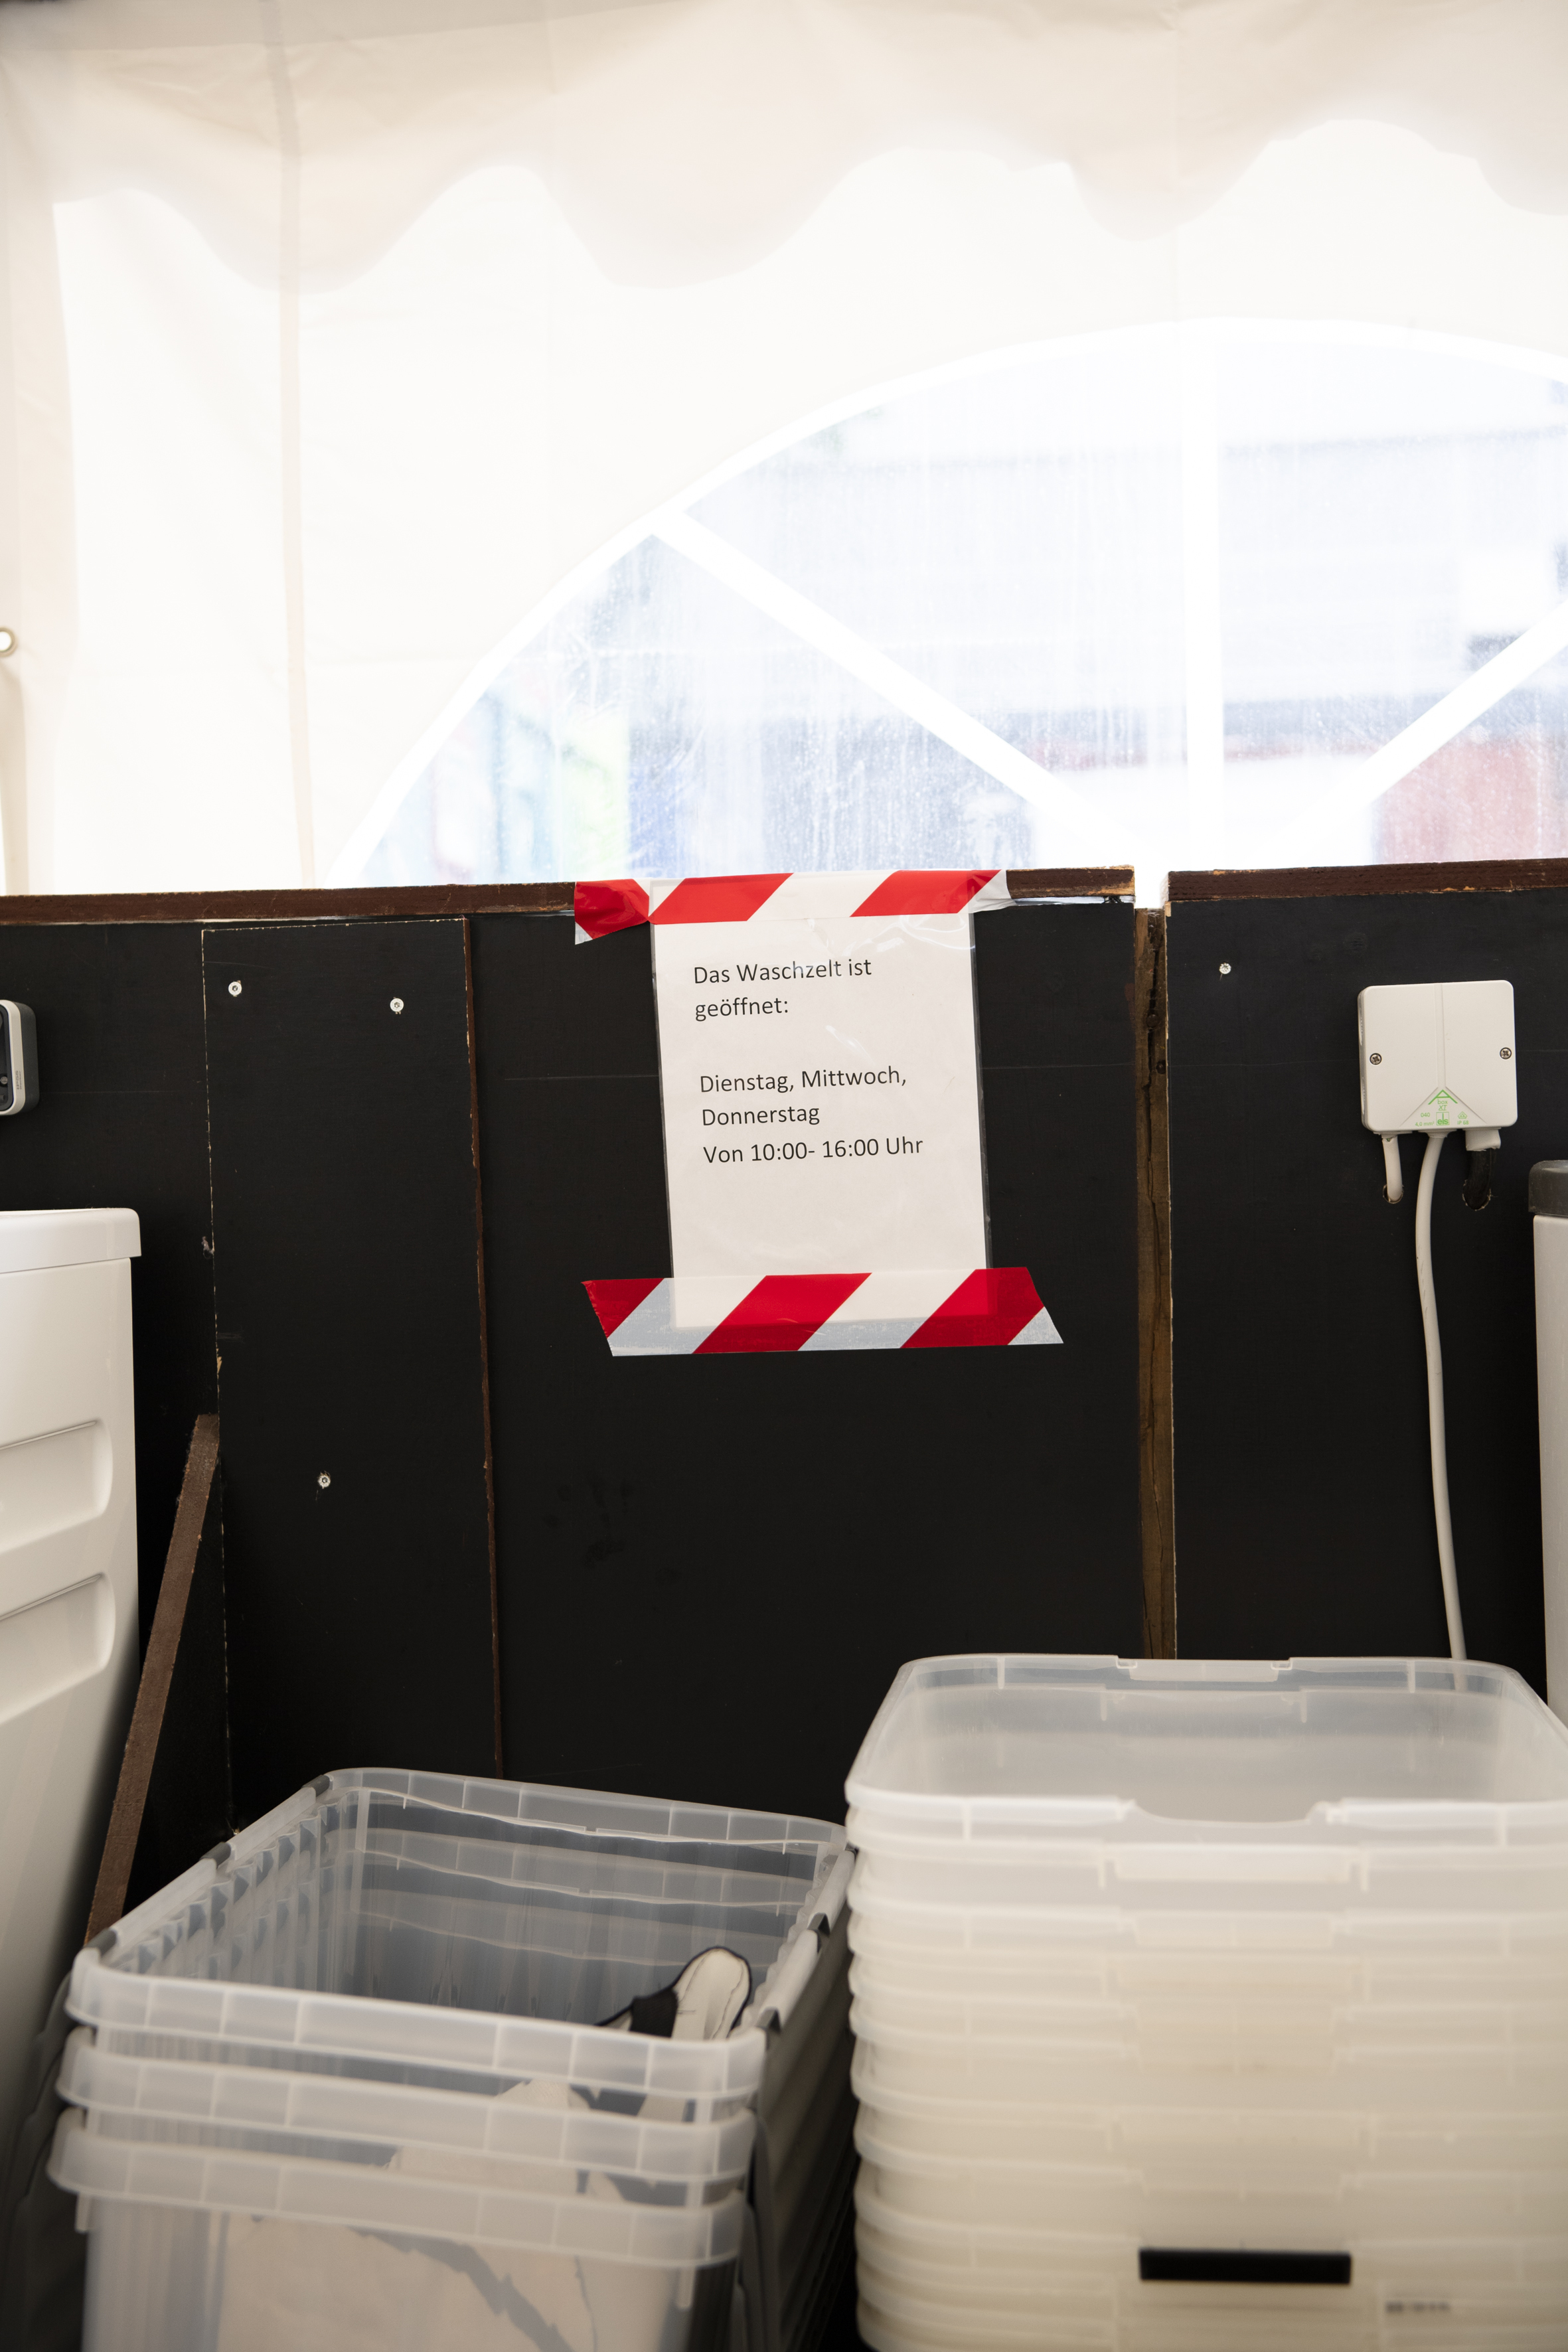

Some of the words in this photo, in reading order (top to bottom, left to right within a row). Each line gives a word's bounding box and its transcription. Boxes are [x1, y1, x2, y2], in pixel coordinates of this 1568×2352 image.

[694, 967, 730, 984] Das
[736, 959, 842, 982] Waschzelt
[848, 959, 872, 977] ist
[695, 997, 789, 1022] geöffnet:
[700, 1075, 794, 1093] Dienstag,
[802, 1065, 907, 1088] Mittwoch,
[702, 1107, 820, 1126] Donnerstag
[703, 1146, 744, 1164] Von
[751, 1142, 815, 1162] 10:00-
[823, 1138, 879, 1158] 16:00
[886, 1136, 923, 1155] Uhr
